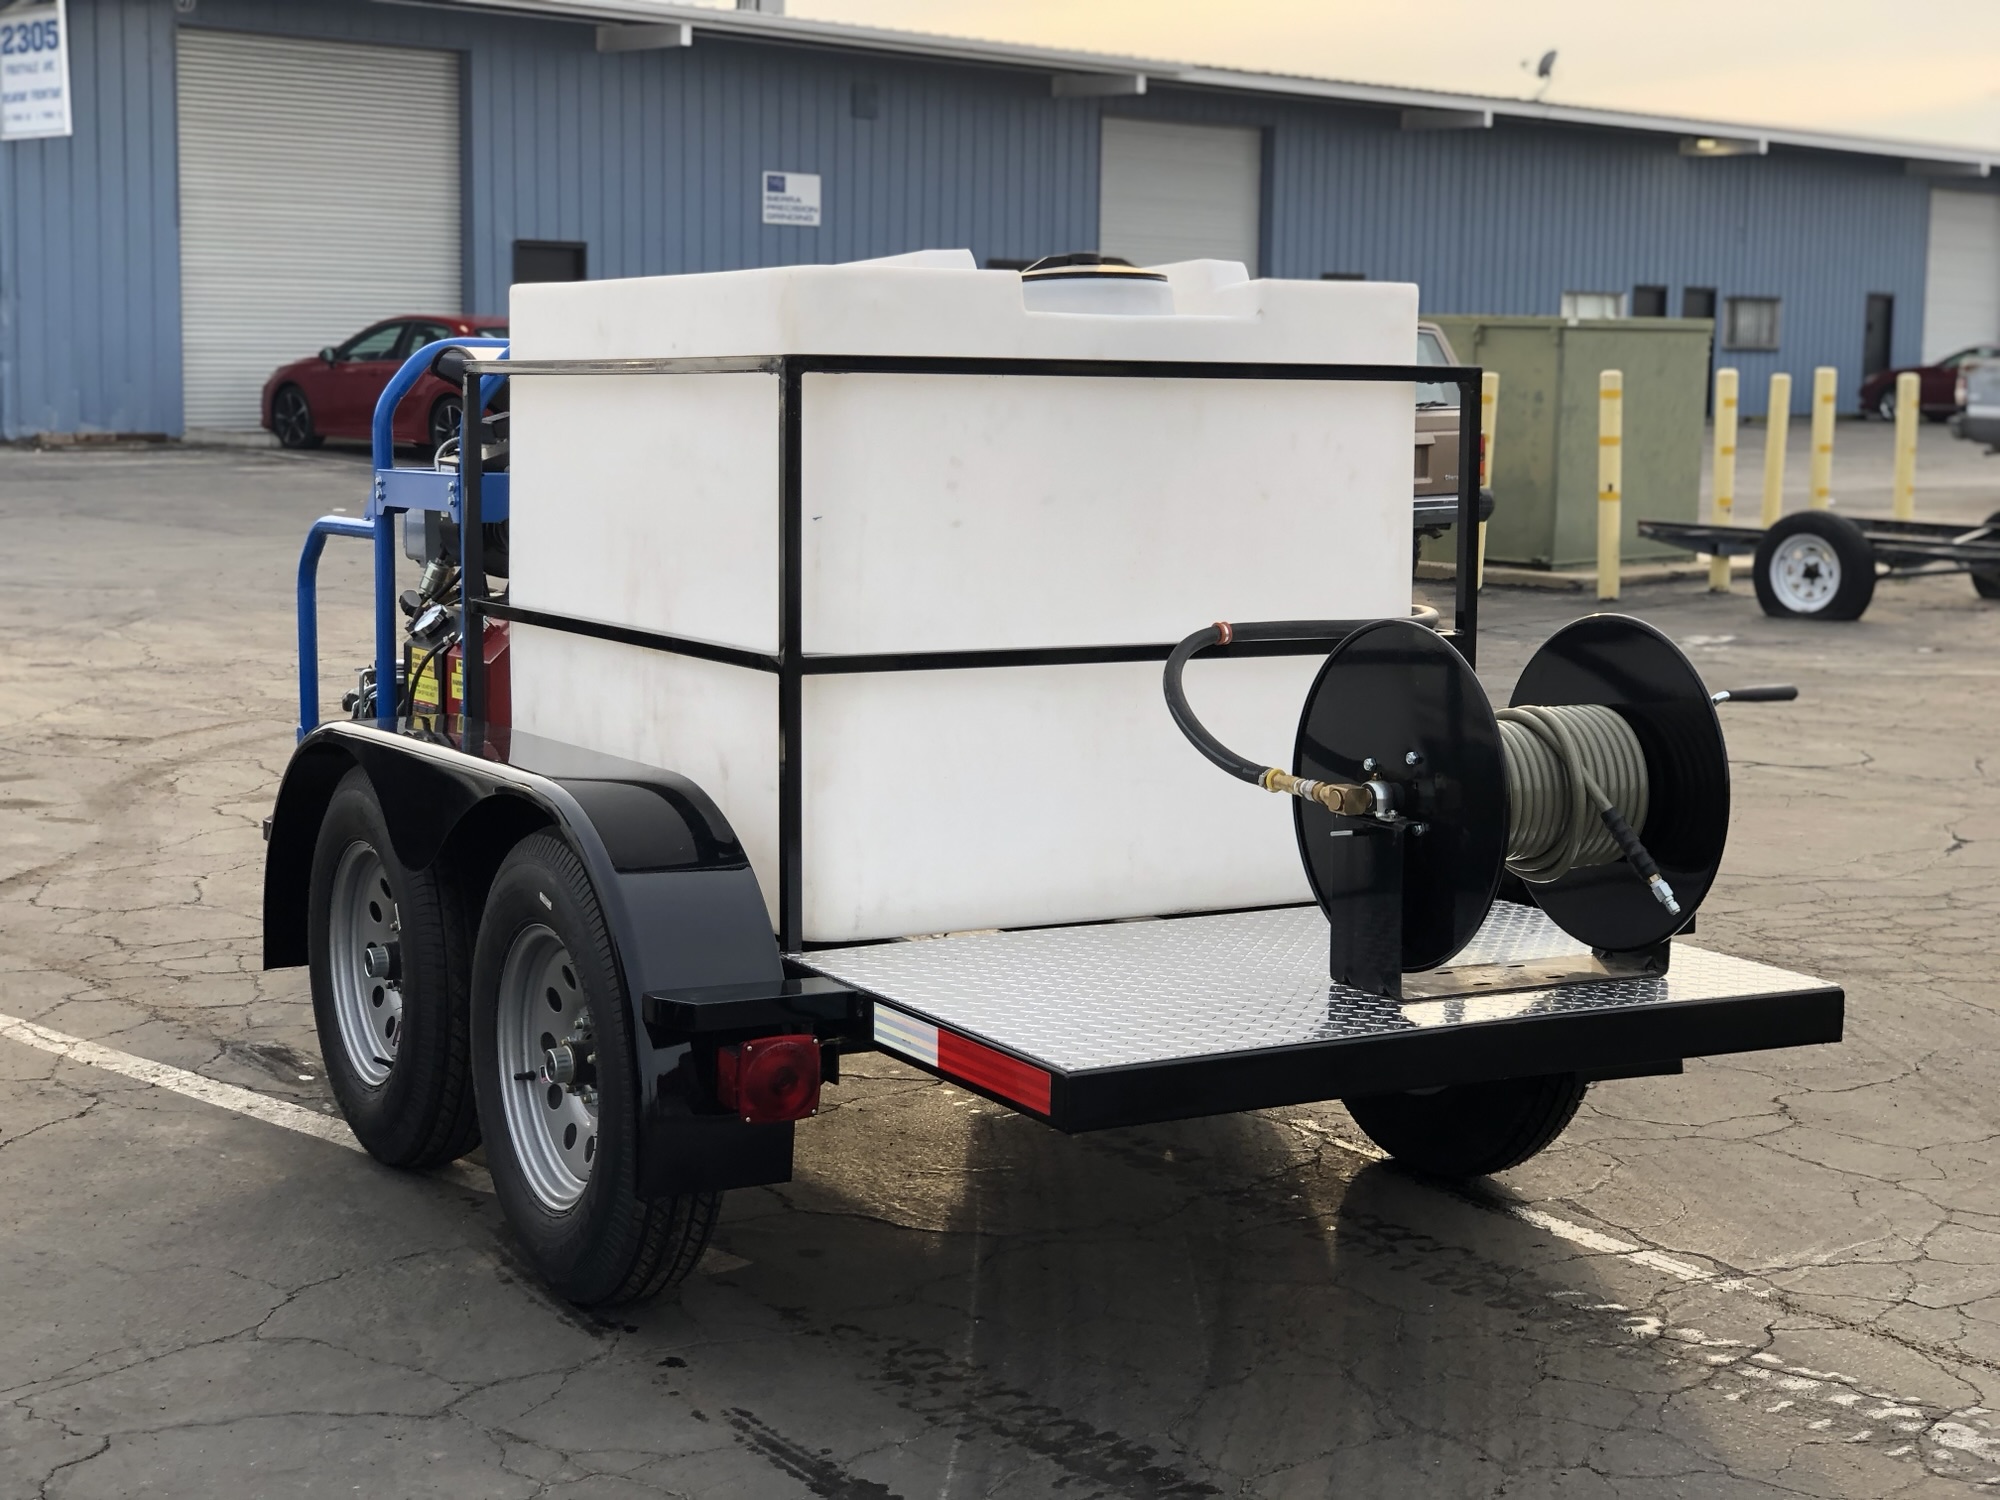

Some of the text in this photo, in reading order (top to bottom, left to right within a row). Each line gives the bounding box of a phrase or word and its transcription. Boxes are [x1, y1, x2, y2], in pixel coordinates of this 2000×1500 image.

[1, 20, 59, 55] 2305
[766, 195, 802, 203] SIERRA
[766, 204, 819, 213] PRECISION
[766, 212, 815, 222] GRINDING
